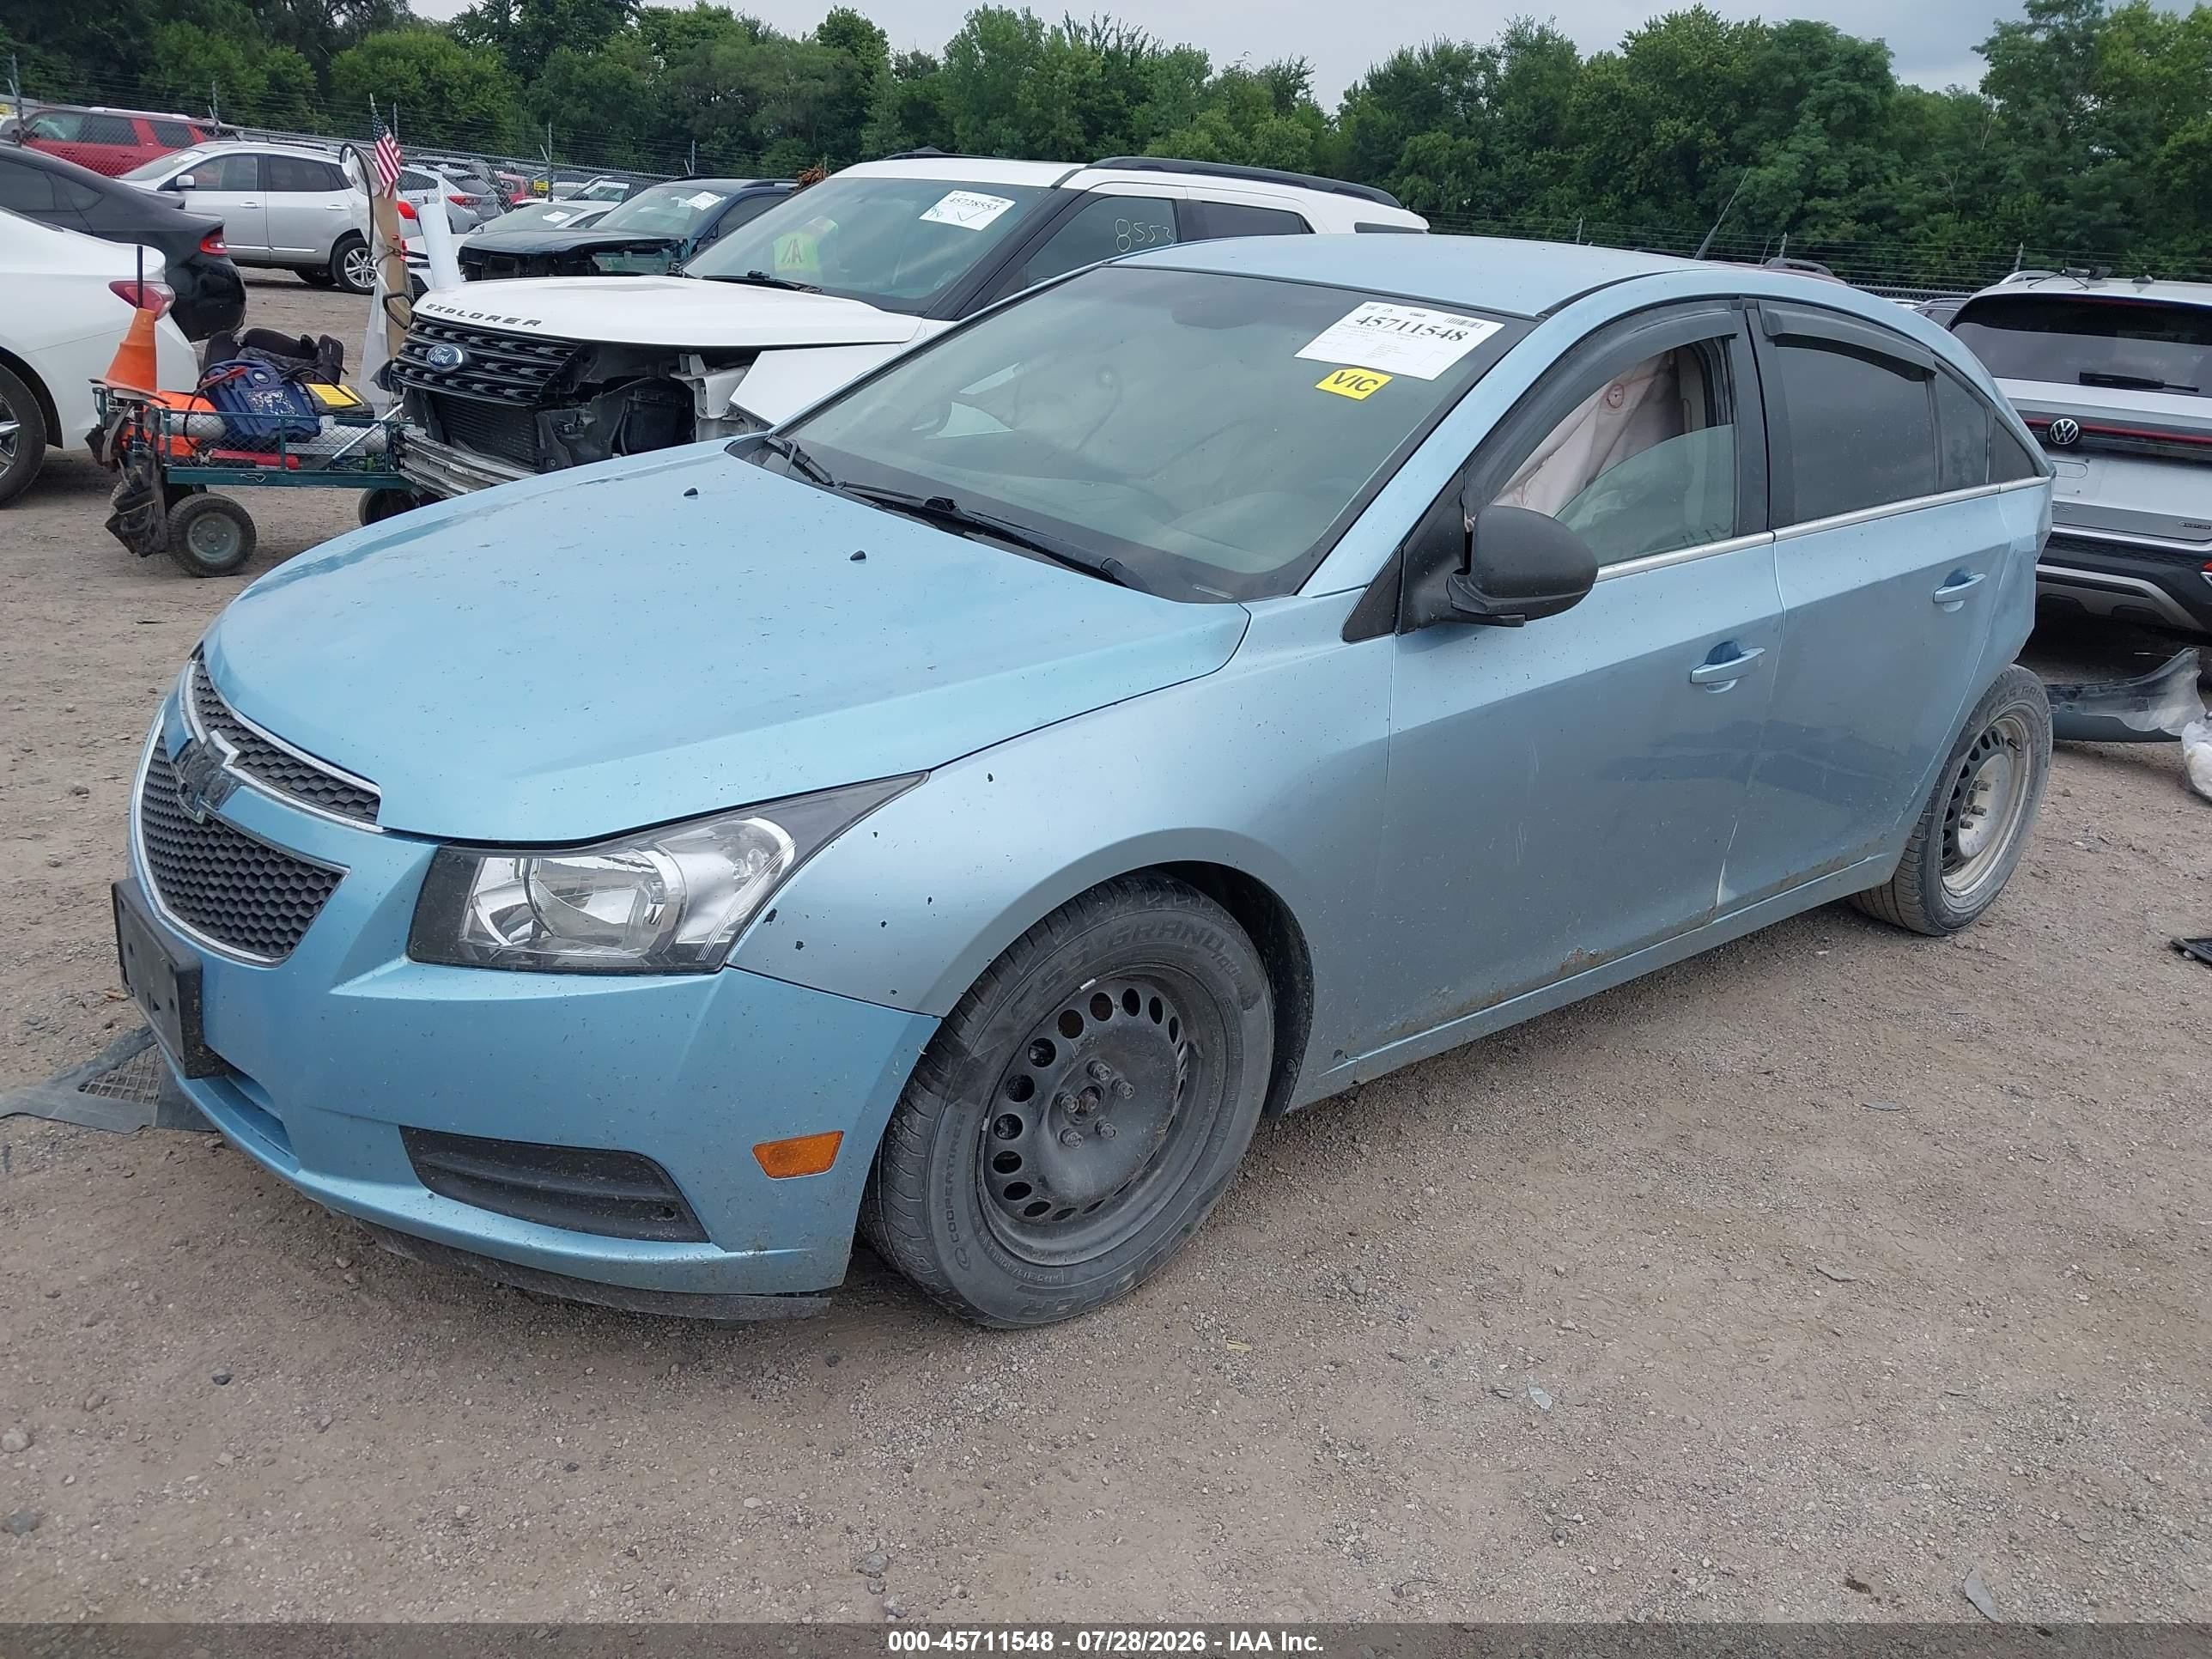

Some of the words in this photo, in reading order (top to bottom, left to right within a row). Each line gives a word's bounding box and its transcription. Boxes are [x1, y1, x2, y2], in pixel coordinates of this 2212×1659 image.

[1115, 218, 1174, 252] 8553
[426, 303, 542, 326] EXPLORER
[1356, 315, 1468, 343] 45711548
[429, 346, 452, 364] Ford
[1332, 371, 1378, 392] VIC
